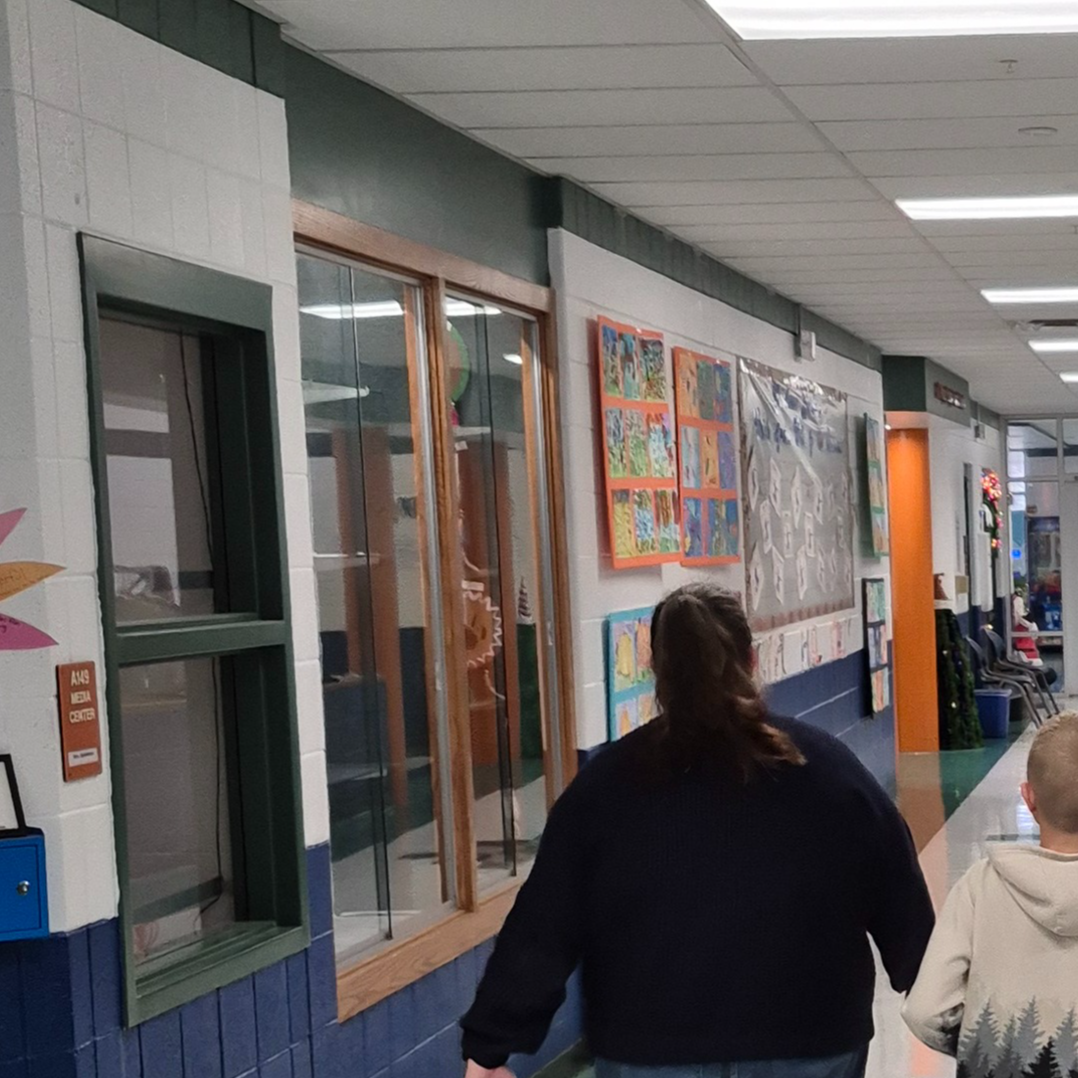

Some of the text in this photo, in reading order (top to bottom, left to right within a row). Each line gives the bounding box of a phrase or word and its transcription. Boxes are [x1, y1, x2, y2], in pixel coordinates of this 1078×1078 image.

[71, 669, 89, 686] A149
[70, 690, 92, 705] MEDIA
[69, 708, 95, 723] CENTER
